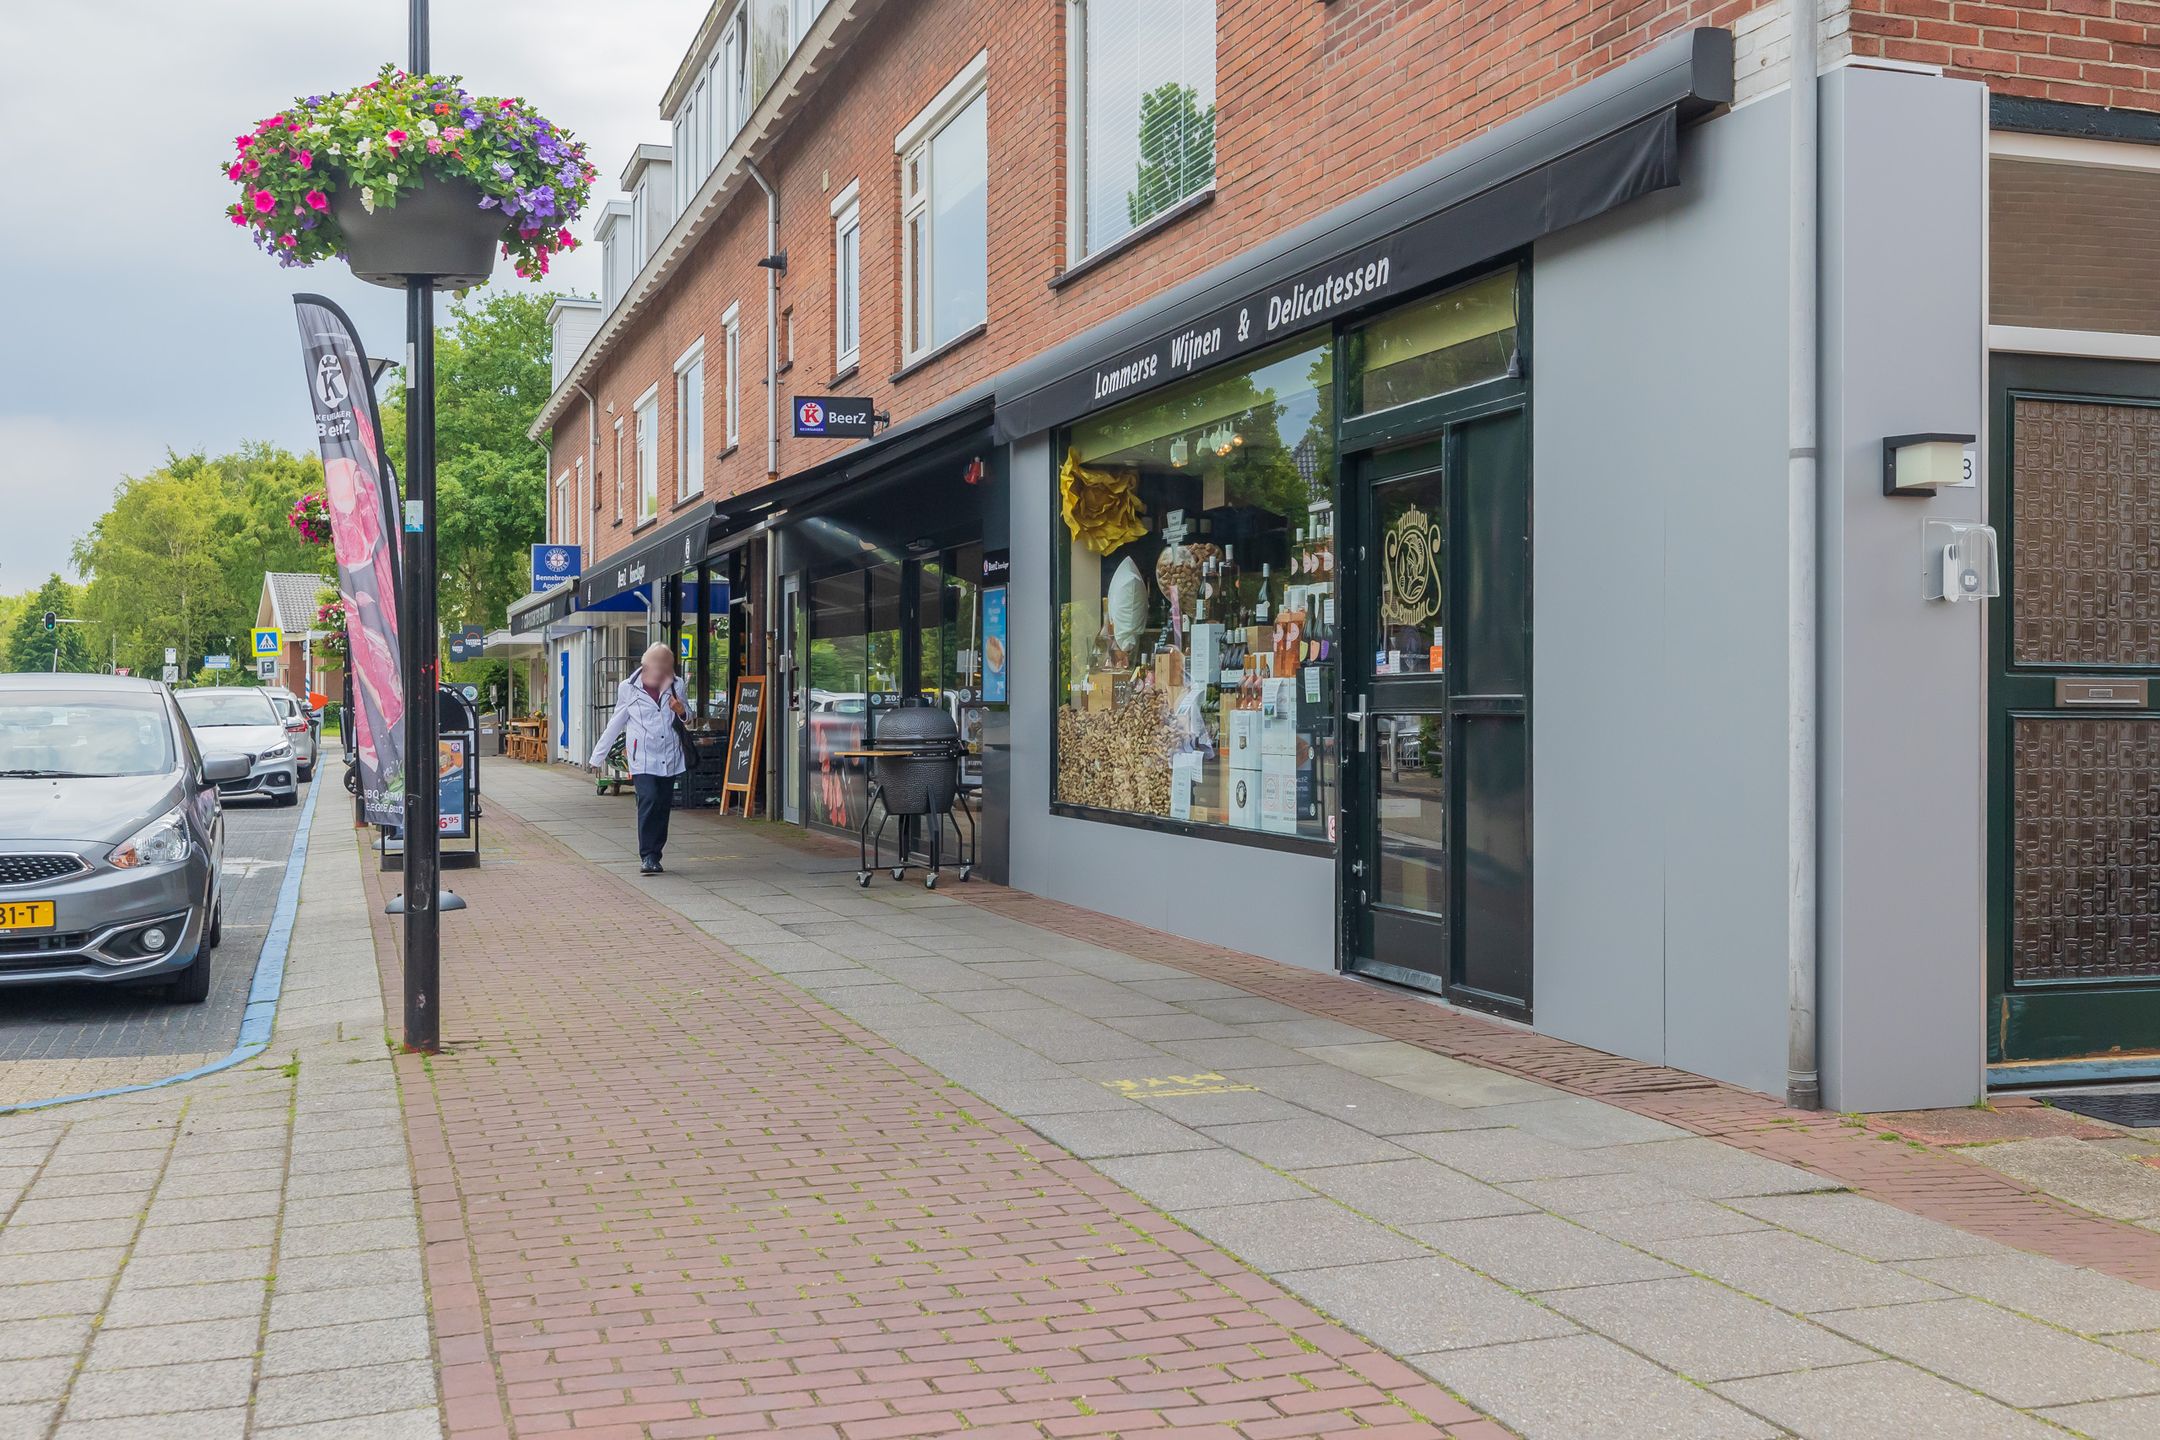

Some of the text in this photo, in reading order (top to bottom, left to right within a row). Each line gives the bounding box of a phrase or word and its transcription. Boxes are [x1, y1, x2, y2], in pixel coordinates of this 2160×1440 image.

[1094, 256, 1390, 400] Lommerse Wijnen & Delicatessen
[321, 368, 344, 402] K
[803, 408, 819, 423] K
[828, 412, 867, 424] BeerZ
